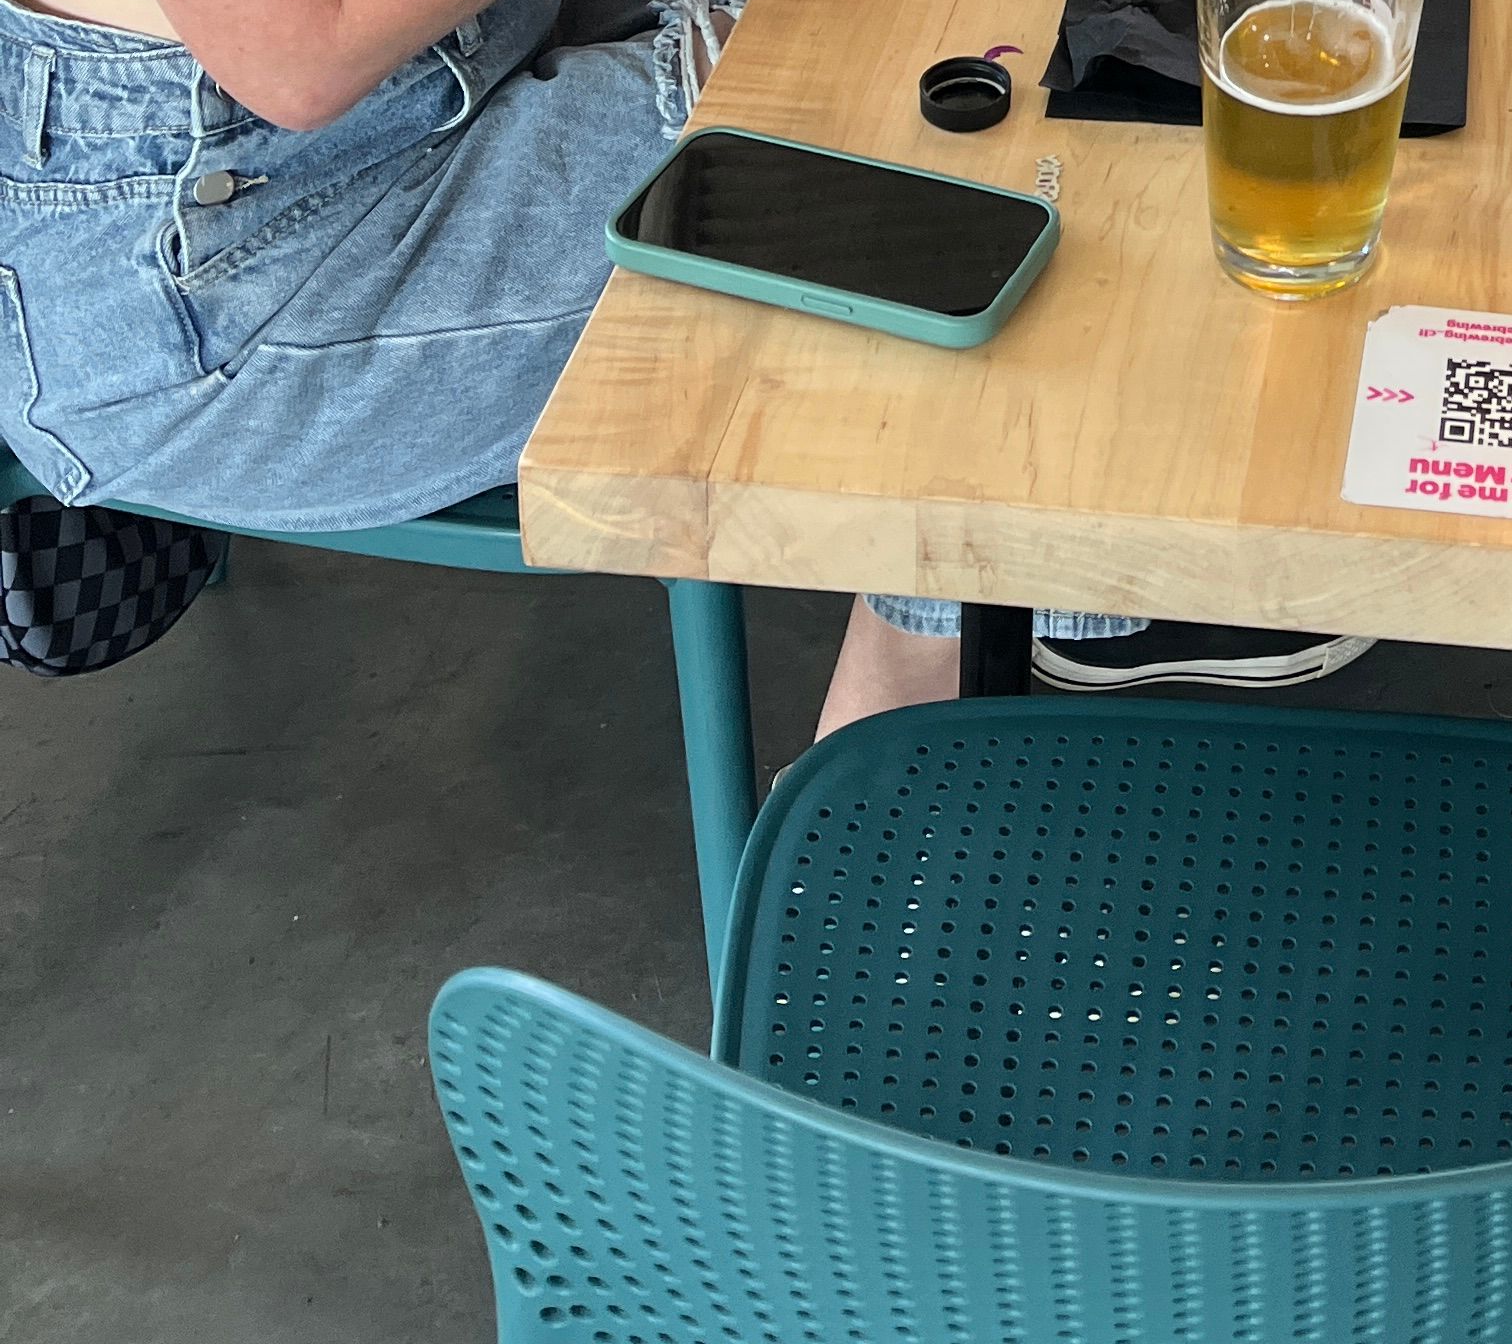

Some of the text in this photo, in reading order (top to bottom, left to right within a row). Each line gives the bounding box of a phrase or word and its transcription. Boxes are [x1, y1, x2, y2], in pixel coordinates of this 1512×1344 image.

[1407, 457, 1506, 485] Menu
[1404, 478, 1451, 500] for
[1457, 484, 1509, 502] me
